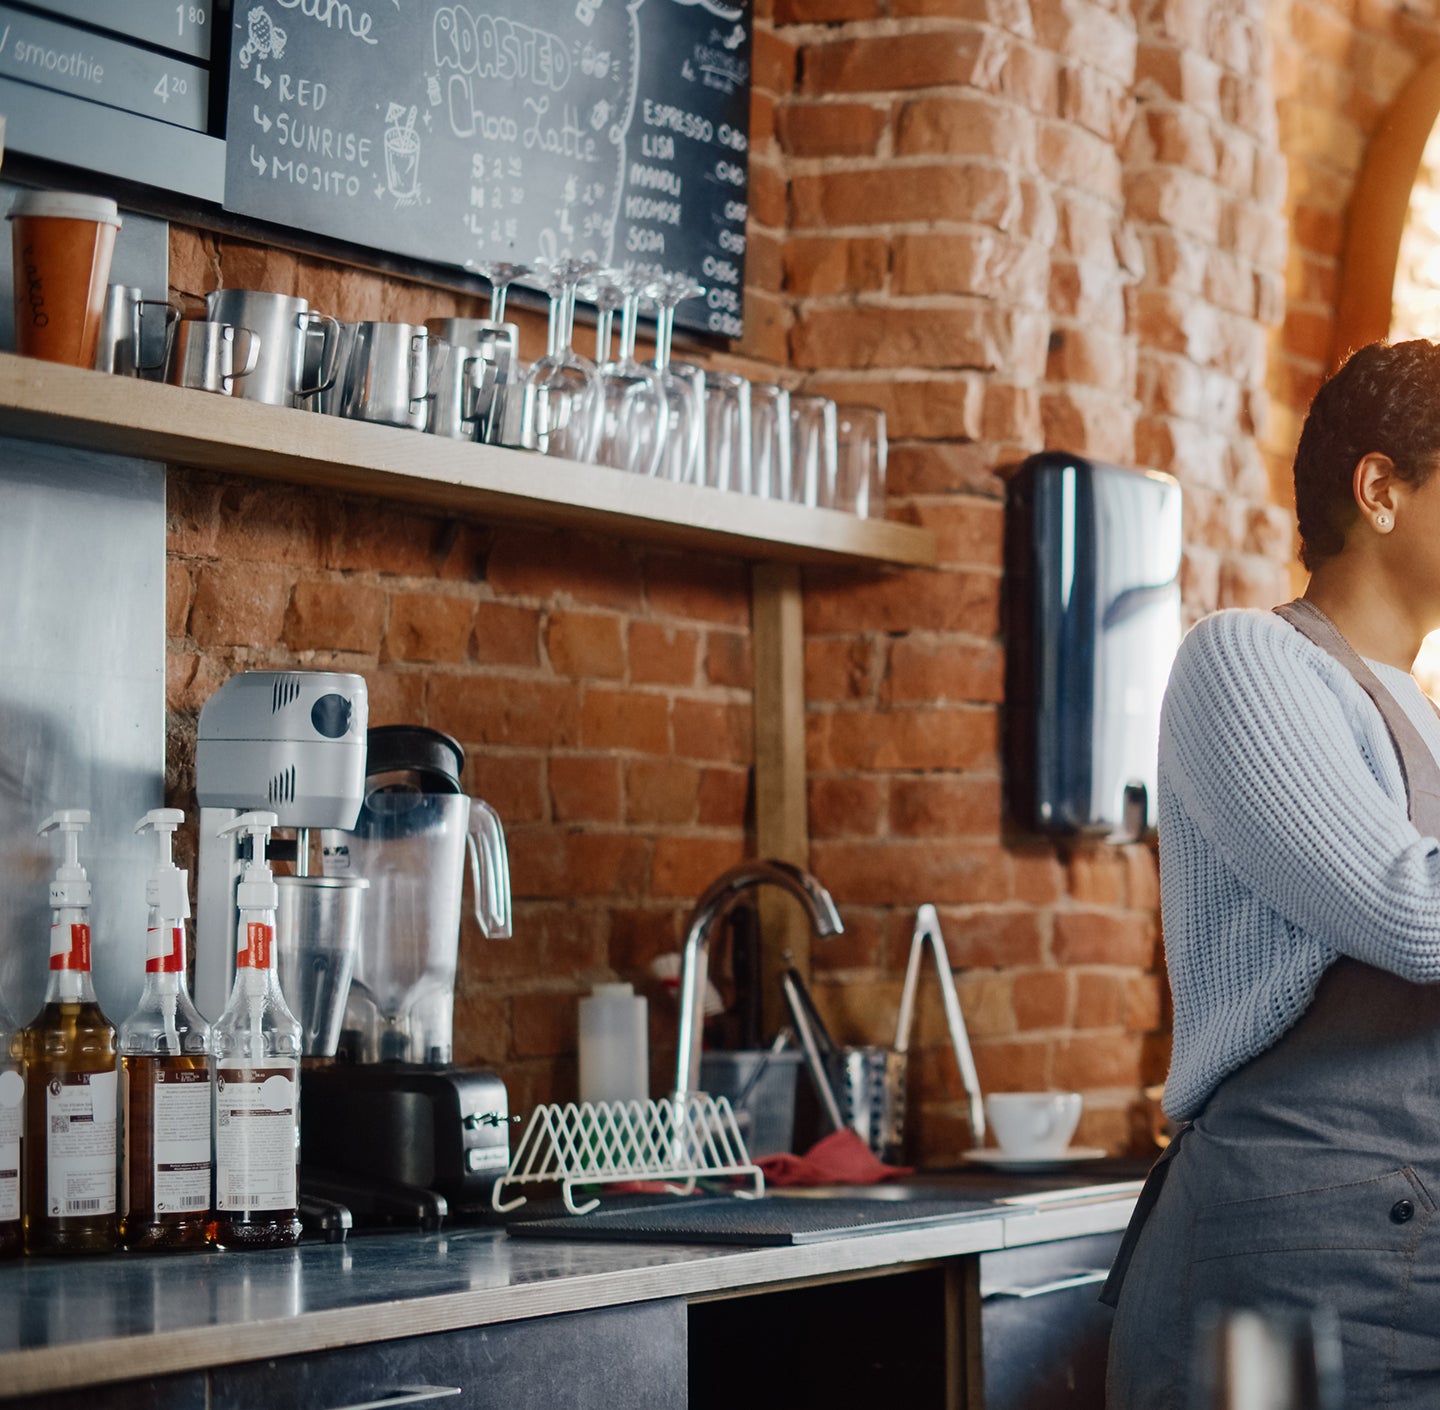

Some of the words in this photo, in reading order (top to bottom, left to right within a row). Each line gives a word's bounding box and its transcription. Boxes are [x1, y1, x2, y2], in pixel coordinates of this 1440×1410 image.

[14, 40, 105, 84] smoothie
[432, 4, 572, 92] ROASTED
[279, 73, 327, 111] RED
[276, 112, 372, 168] SUNRISE
[523, 95, 599, 162] Latte
[642, 98, 714, 143] ESPRESSO
[271, 155, 360, 197] MOJITO
